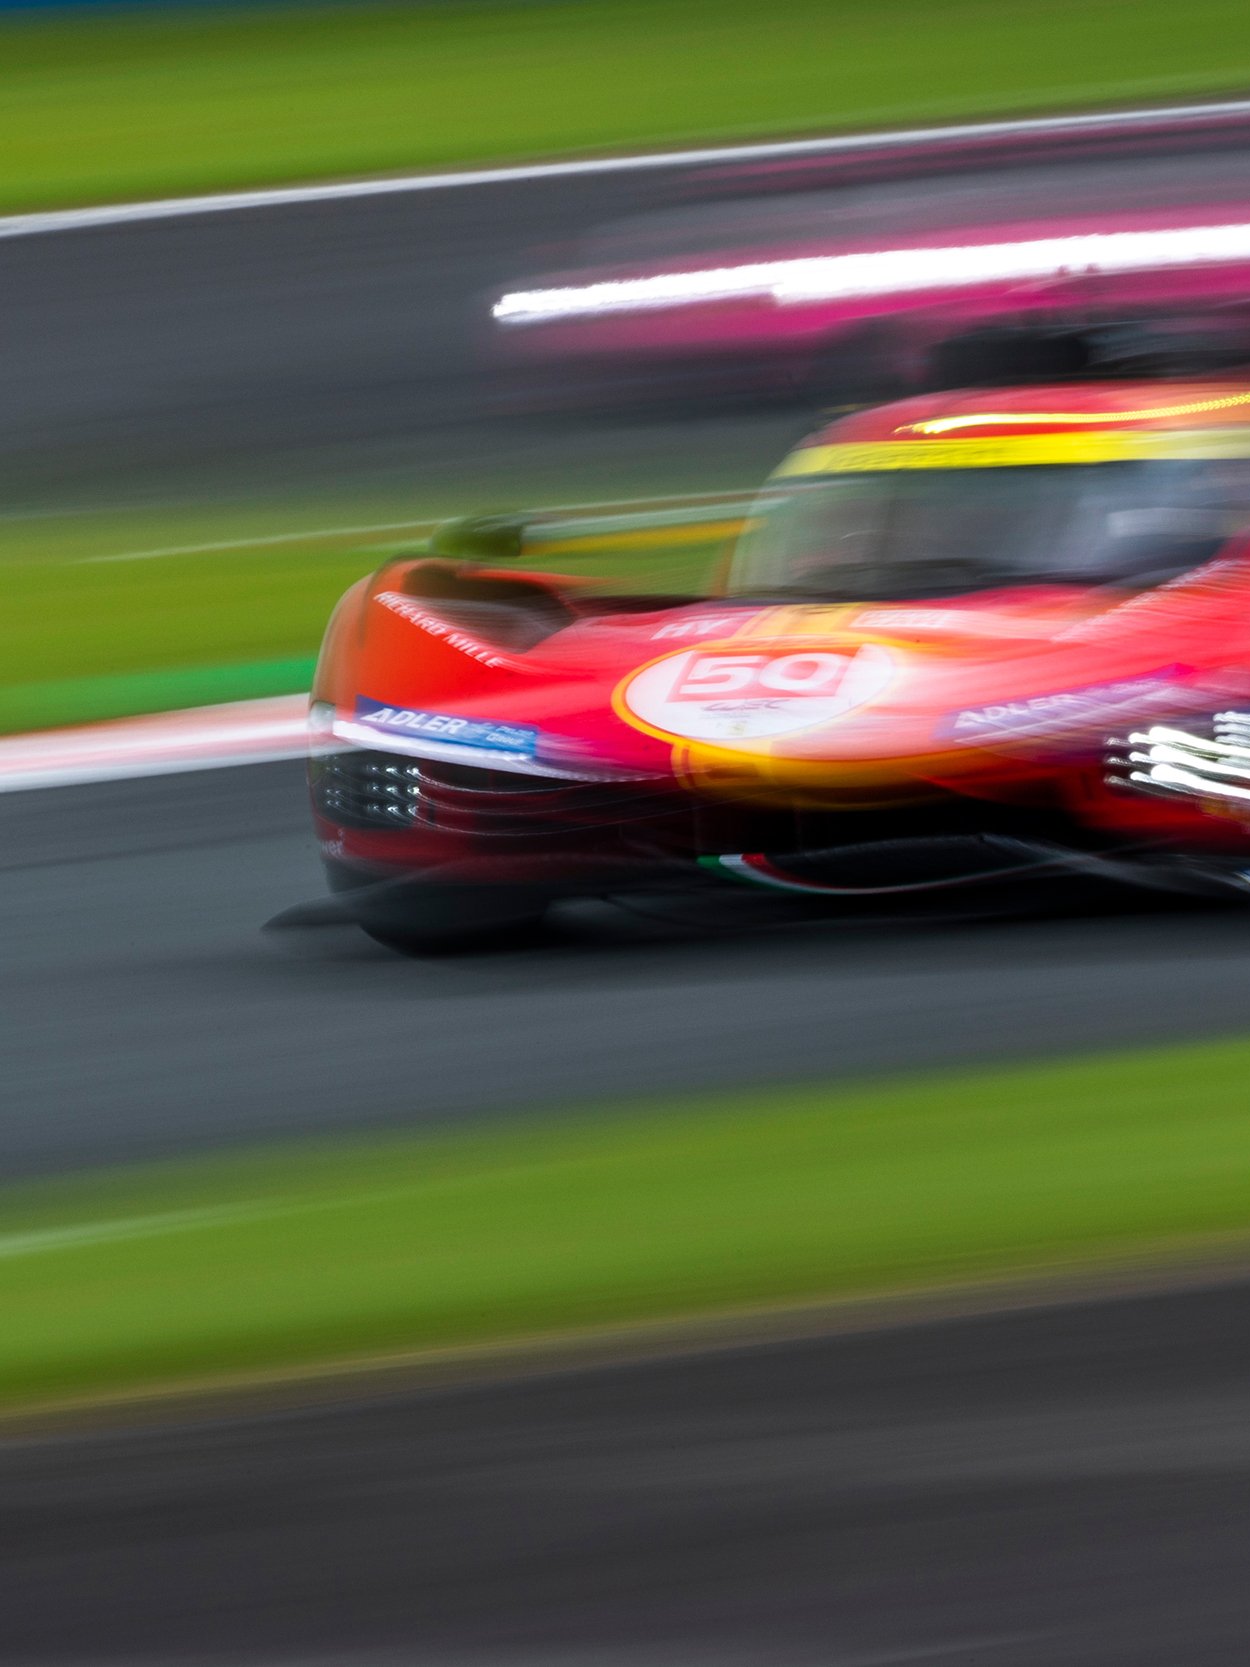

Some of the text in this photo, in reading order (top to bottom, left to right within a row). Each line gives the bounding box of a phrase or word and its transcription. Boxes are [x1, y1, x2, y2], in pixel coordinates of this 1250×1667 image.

[442, 632, 504, 668] MILLE
[679, 652, 843, 696] 50
[360, 707, 468, 733] ADLER
